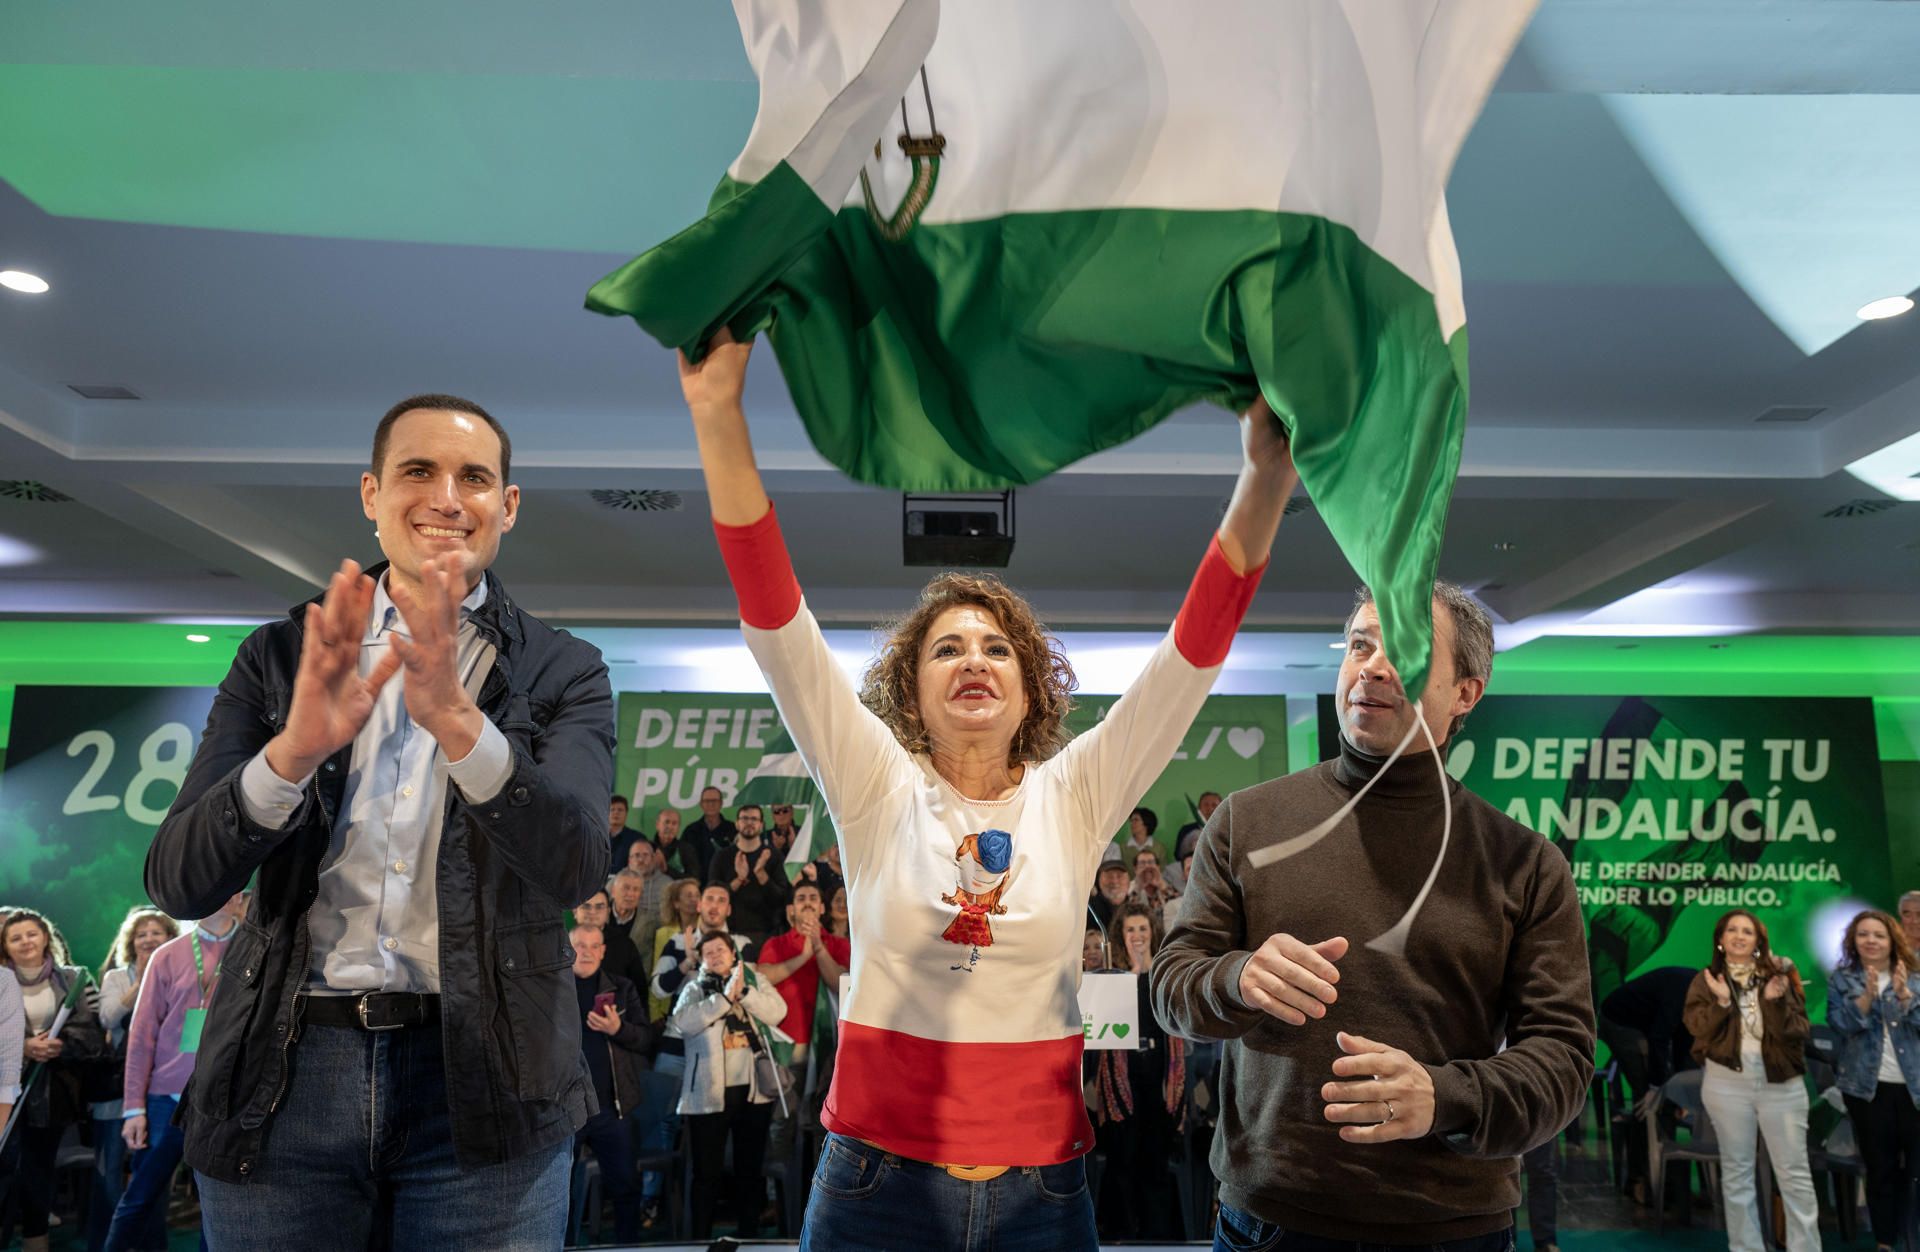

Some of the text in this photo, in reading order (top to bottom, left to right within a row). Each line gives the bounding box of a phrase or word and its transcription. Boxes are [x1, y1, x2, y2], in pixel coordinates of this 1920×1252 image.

[634, 708, 783, 749] DEFIE
[1492, 737, 1831, 783] DEFIENDE TU
[1504, 785, 1837, 843] ANDALUCÍA.
[1597, 861, 1707, 882] DEFENDER
[1711, 858, 1842, 882] ANDALUCÍA
[1647, 886, 1678, 907] LO
[1683, 881, 1783, 907] PÚBLICO.
